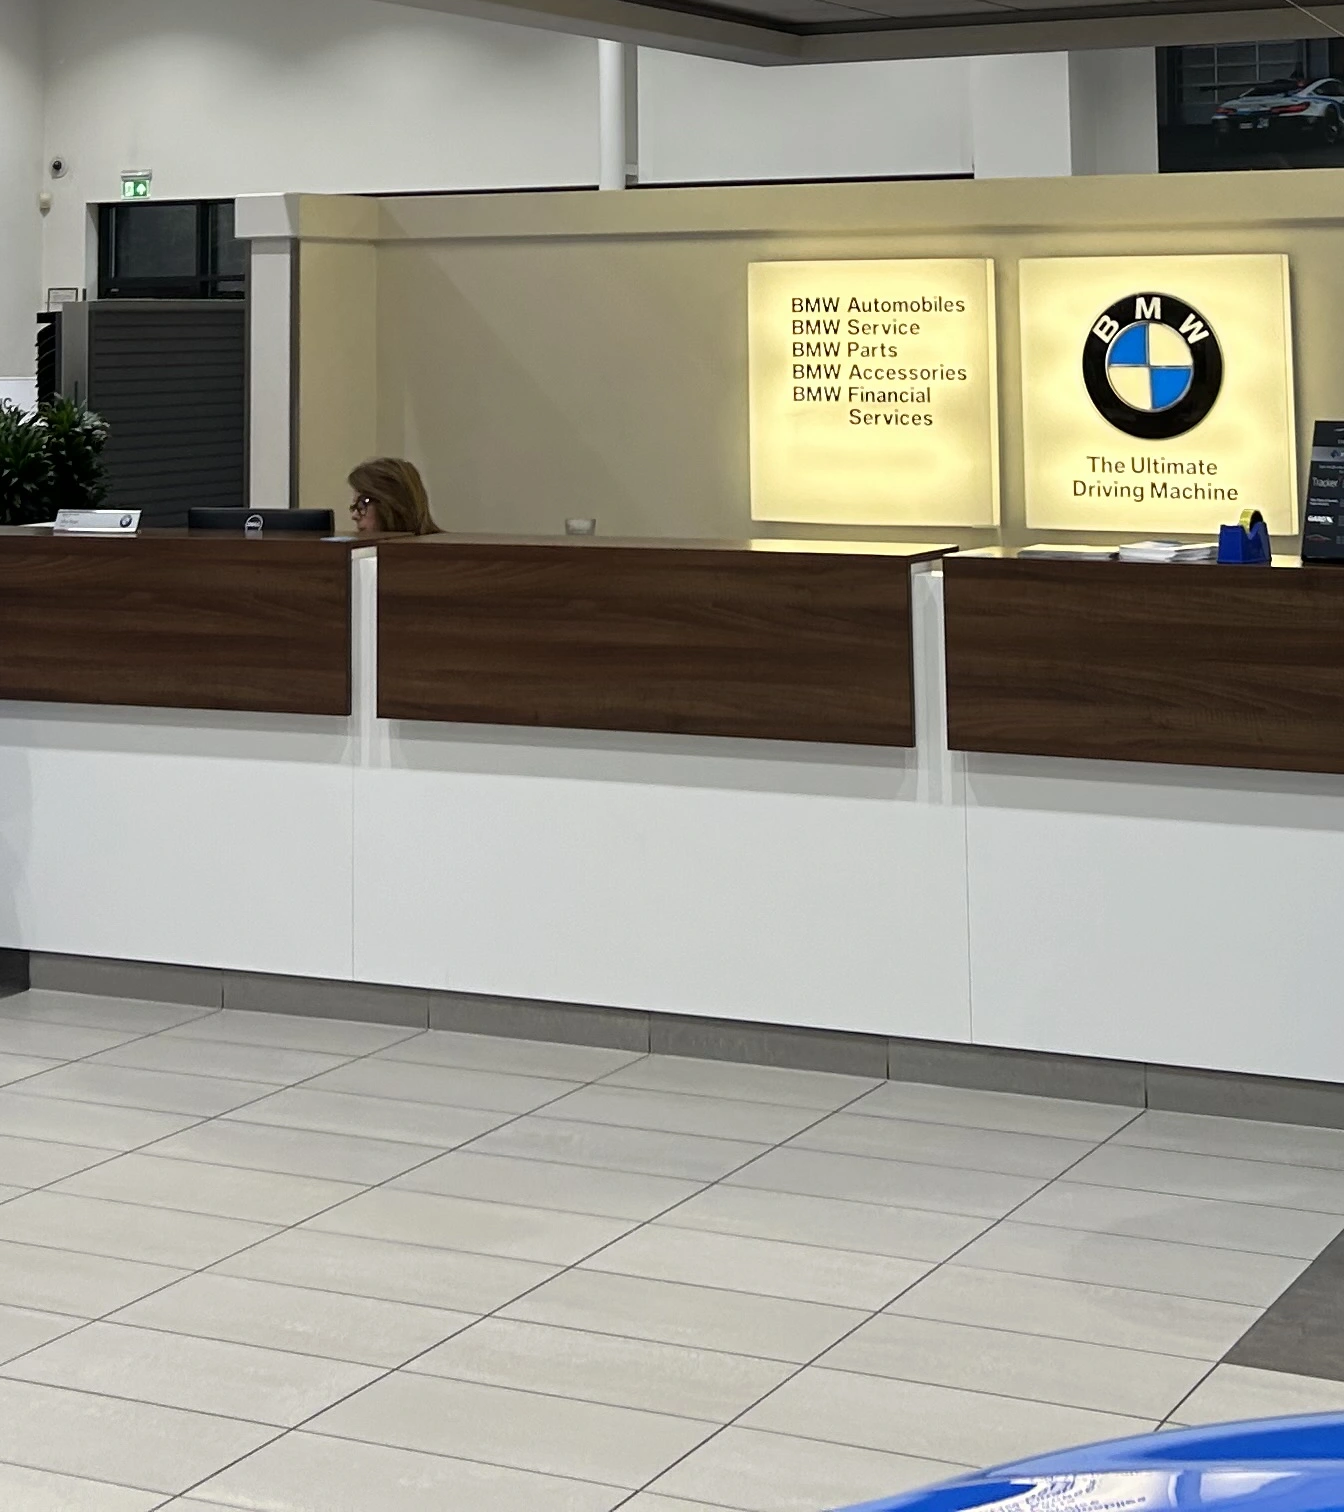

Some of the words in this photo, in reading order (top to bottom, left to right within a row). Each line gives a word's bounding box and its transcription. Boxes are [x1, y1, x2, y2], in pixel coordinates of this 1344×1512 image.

[791, 297, 840, 313] BMW
[847, 296, 966, 313] Automobiles
[792, 319, 840, 335] BMW
[847, 318, 920, 335] Service
[1092, 296, 1210, 345] BMW
[792, 342, 840, 357] BMW
[847, 342, 898, 358] Parts
[793, 364, 841, 379] BMW
[848, 364, 968, 381] Accessories
[793, 386, 841, 402] BMW
[849, 386, 931, 403] Financial
[849, 408, 933, 426] Services
[1086, 456, 1126, 473] The
[1131, 456, 1218, 476] Ultimate
[1073, 480, 1144, 502] Driving
[1150, 482, 1239, 501] Machine
